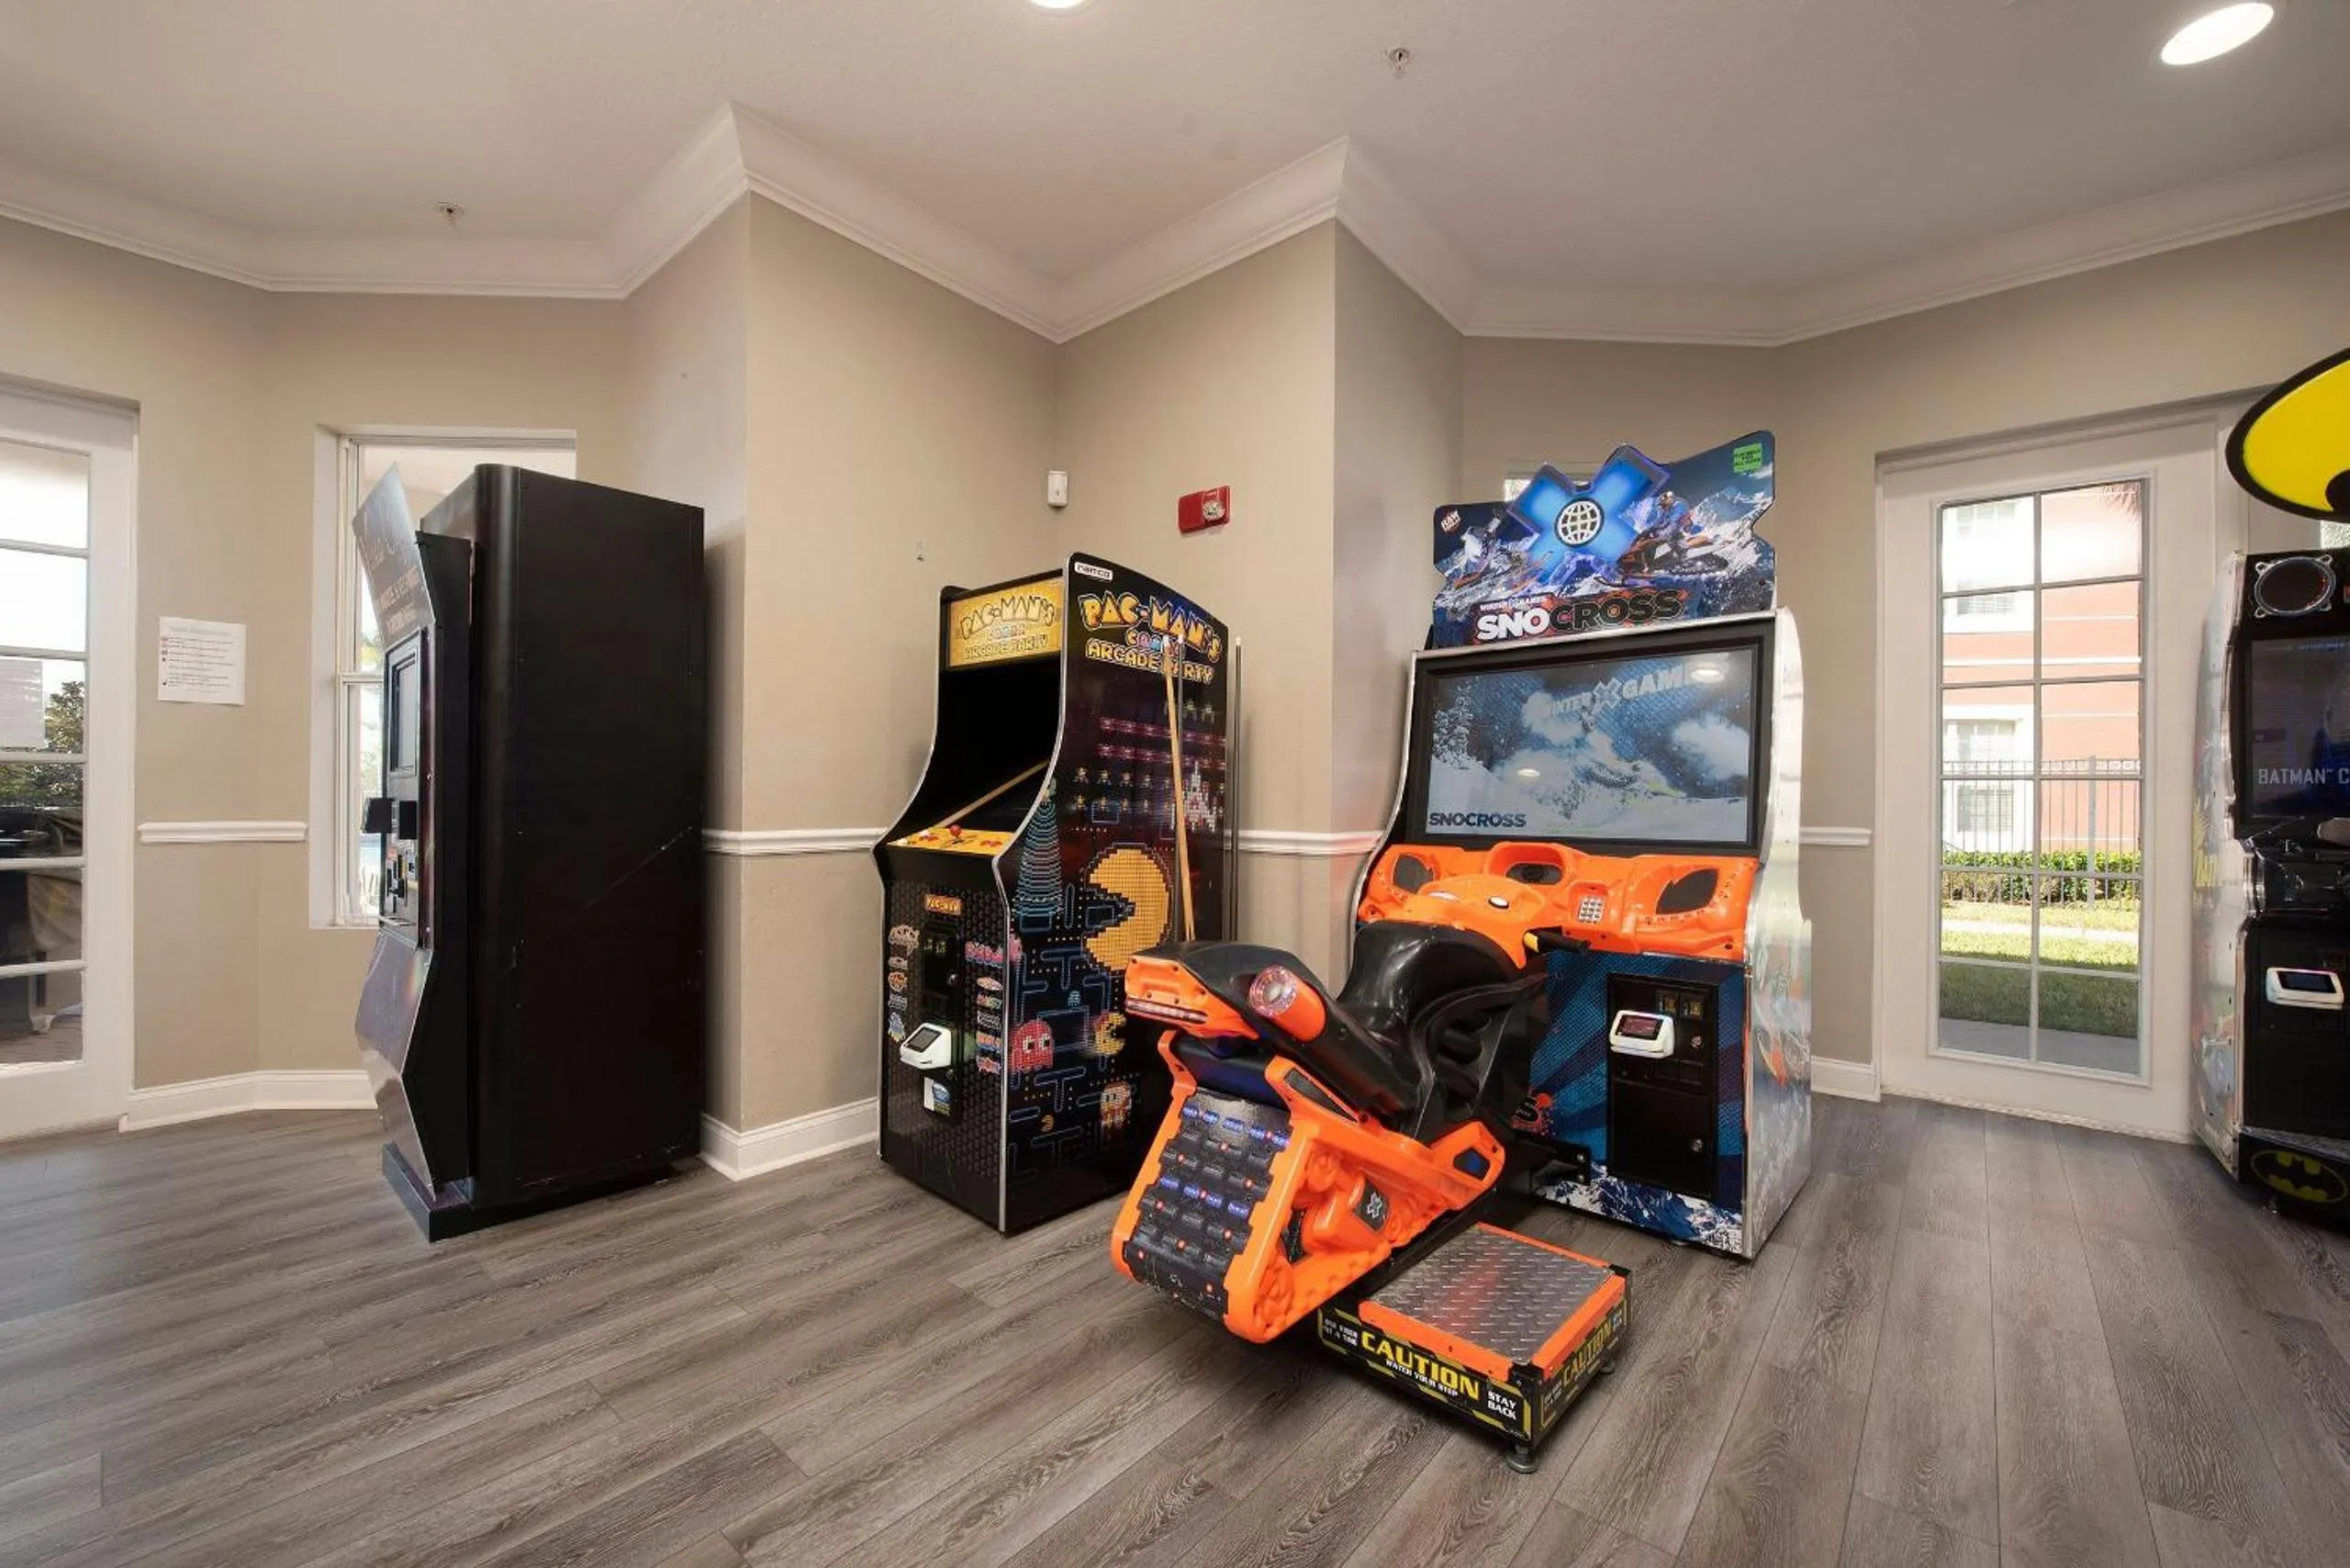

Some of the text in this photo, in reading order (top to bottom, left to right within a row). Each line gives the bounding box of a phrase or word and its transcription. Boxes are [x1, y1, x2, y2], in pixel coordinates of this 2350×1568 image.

[960, 595, 1055, 640] PAC-MAN'S
[1078, 590, 1222, 662] PAC-MAN'S
[1477, 589, 1684, 641] SNOCROSS
[1086, 638, 1161, 672] ARCADE
[1428, 812, 1527, 827] SNOCROSS
[1361, 1331, 1479, 1401] CAUTION
[1386, 1359, 1412, 1376] WATCH
[1488, 1391, 1516, 1409] STAY
[1488, 1400, 1516, 1420] BACK
